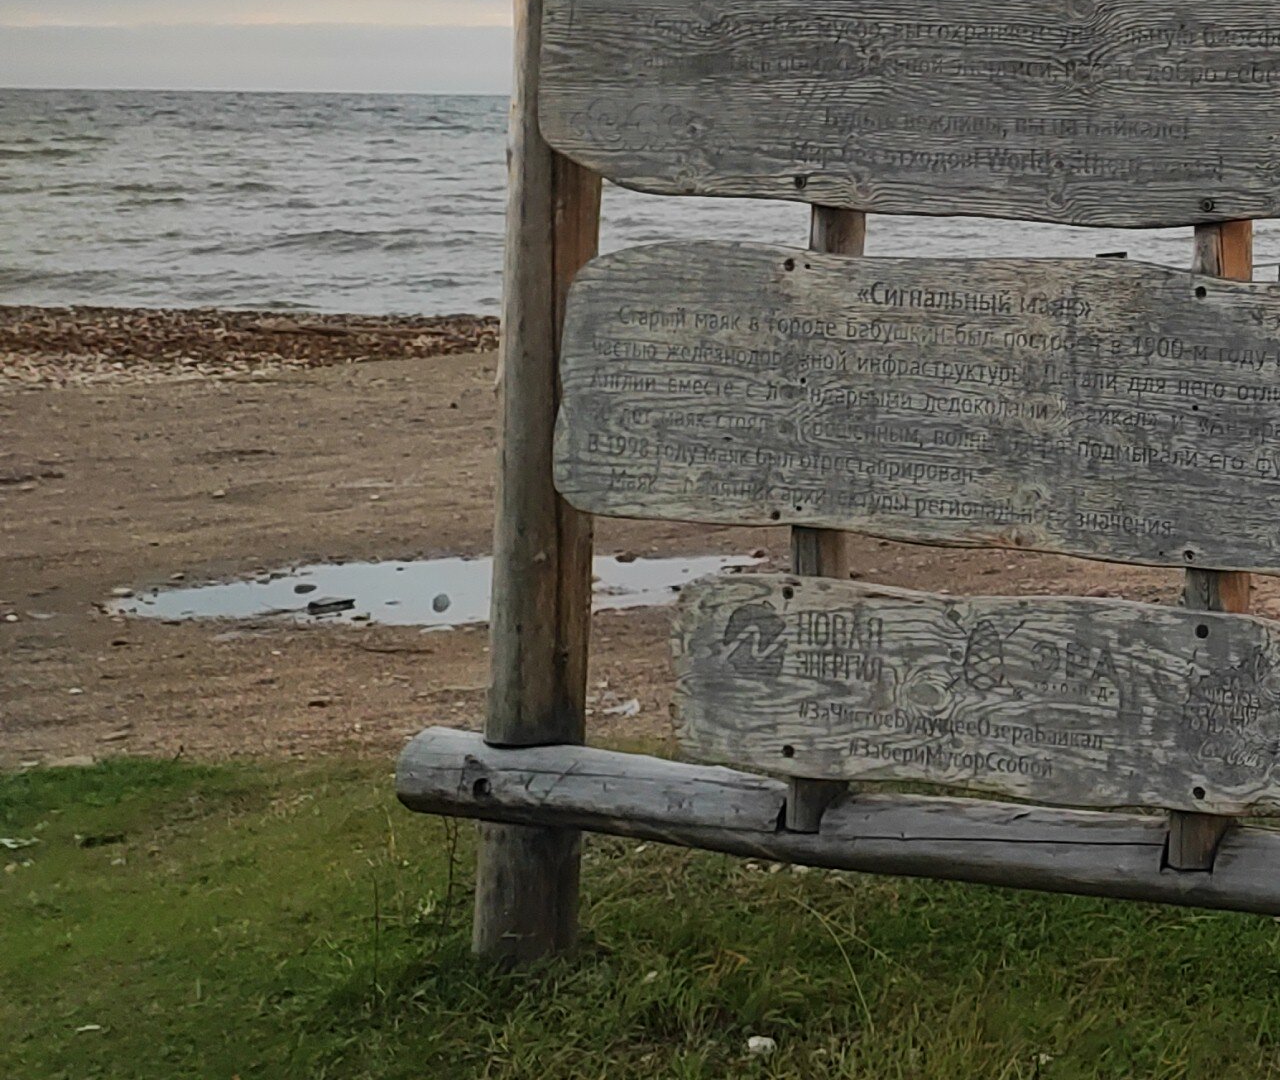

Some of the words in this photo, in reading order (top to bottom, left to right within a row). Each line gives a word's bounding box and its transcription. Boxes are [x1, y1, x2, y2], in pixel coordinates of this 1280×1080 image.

[856, 281, 1011, 314] «Сигнальный
[619, 304, 685, 332] Старый
[694, 312, 740, 331] маяк
[749, 318, 760, 332] в
[845, 319, 946, 345] Бабушкин
[954, 322, 993, 347] был
[1110, 339, 1123, 355] в
[1134, 336, 1209, 366] 1900-м
[1218, 348, 1268, 371] году
[591, 335, 657, 358] частью
[666, 343, 847, 373] железнодорожной
[1043, 364, 1118, 394] Детали
[1127, 374, 1167, 396] для
[1177, 379, 1226, 400] него
[589, 368, 657, 392] Англии
[667, 379, 734, 398] вместе
[746, 382, 756, 398] с
[924, 392, 1050, 418] ледоколами
[1170, 413, 1184, 429] и
[588, 433, 599, 453] В
[607, 435, 650, 458] 1998
[655, 441, 698, 466] году
[1077, 441, 1199, 467] подмывали
[1208, 452, 1245, 469] его
[1075, 512, 1177, 537] значения.
[796, 610, 884, 648] НОВАЯ
[795, 650, 885, 682] ЭНЕРГИЯ
[1031, 639, 1118, 682] ЭРА
[849, 737, 1053, 777] #ЗабериМусорСсобой
